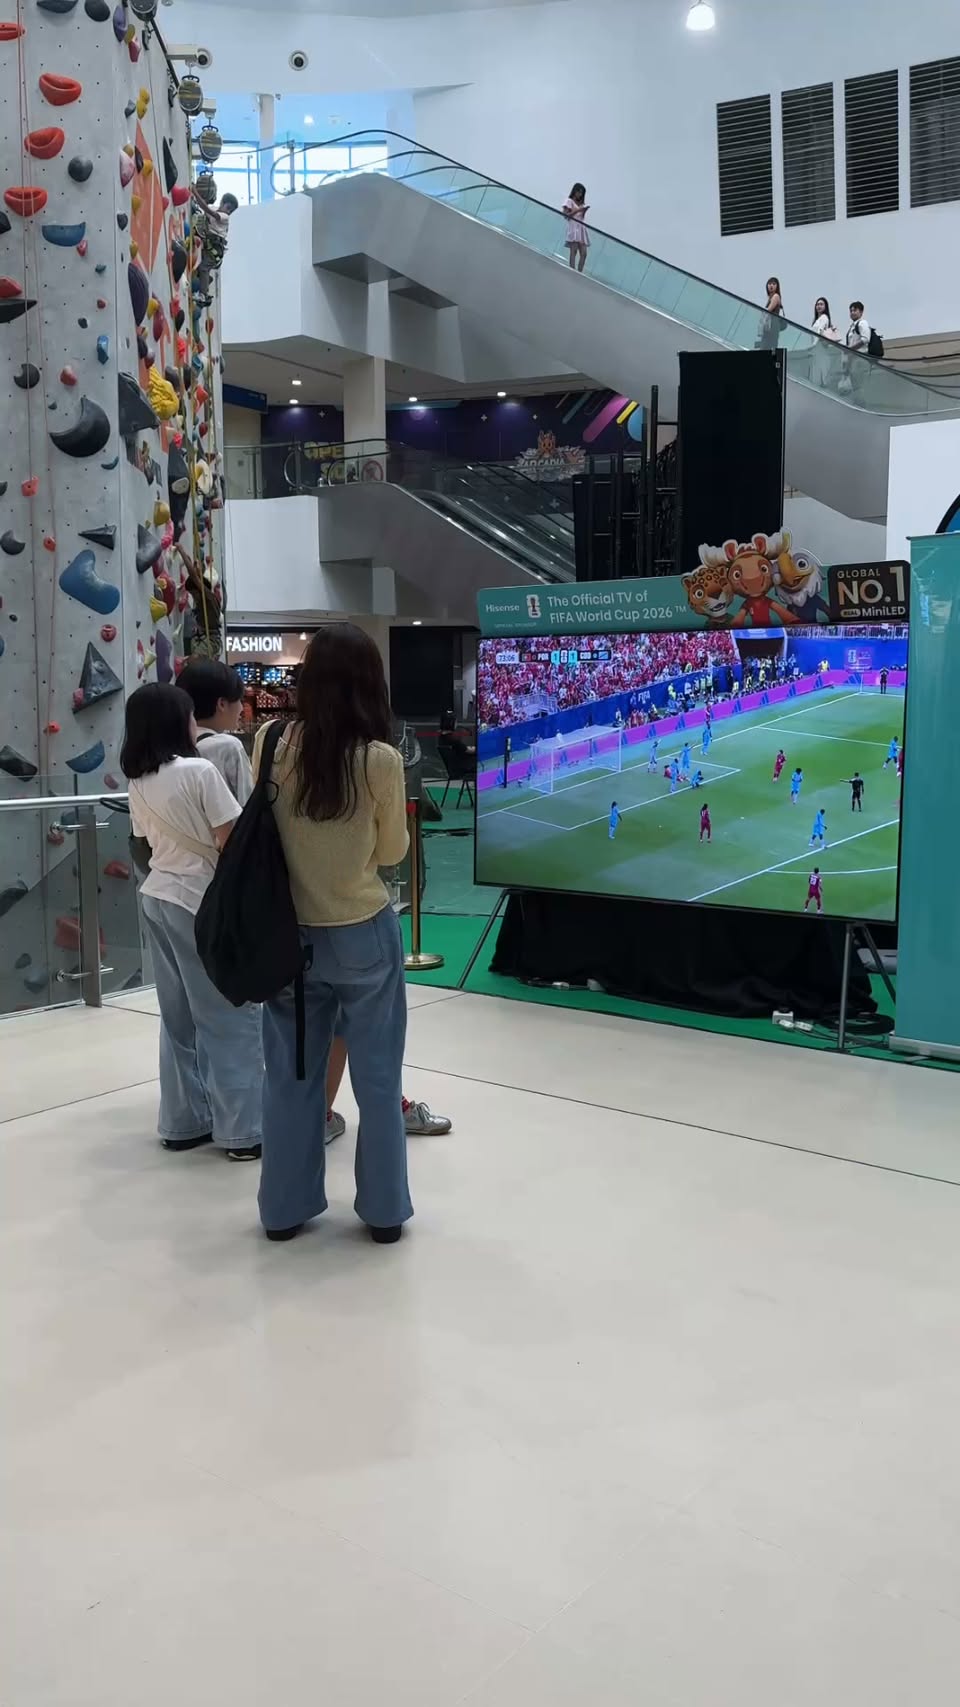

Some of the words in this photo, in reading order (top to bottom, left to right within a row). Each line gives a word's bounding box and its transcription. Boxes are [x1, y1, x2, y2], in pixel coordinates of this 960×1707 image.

[304, 441, 344, 460] OPE
[837, 568, 881, 579] GLOBAL
[837, 566, 906, 605] NO.1
[547, 596, 569, 608] The
[571, 592, 615, 606] Official
[616, 591, 633, 604] TV
[635, 590, 648, 603] of
[485, 603, 520, 613] Hisense
[550, 611, 575, 624] FIFA
[577, 608, 612, 622] World
[614, 607, 641, 623] Cup
[643, 606, 673, 619] 2026
[862, 606, 906, 617] MiniLED
[226, 636, 283, 652] FASHION
[537, 652, 549, 661] POR
